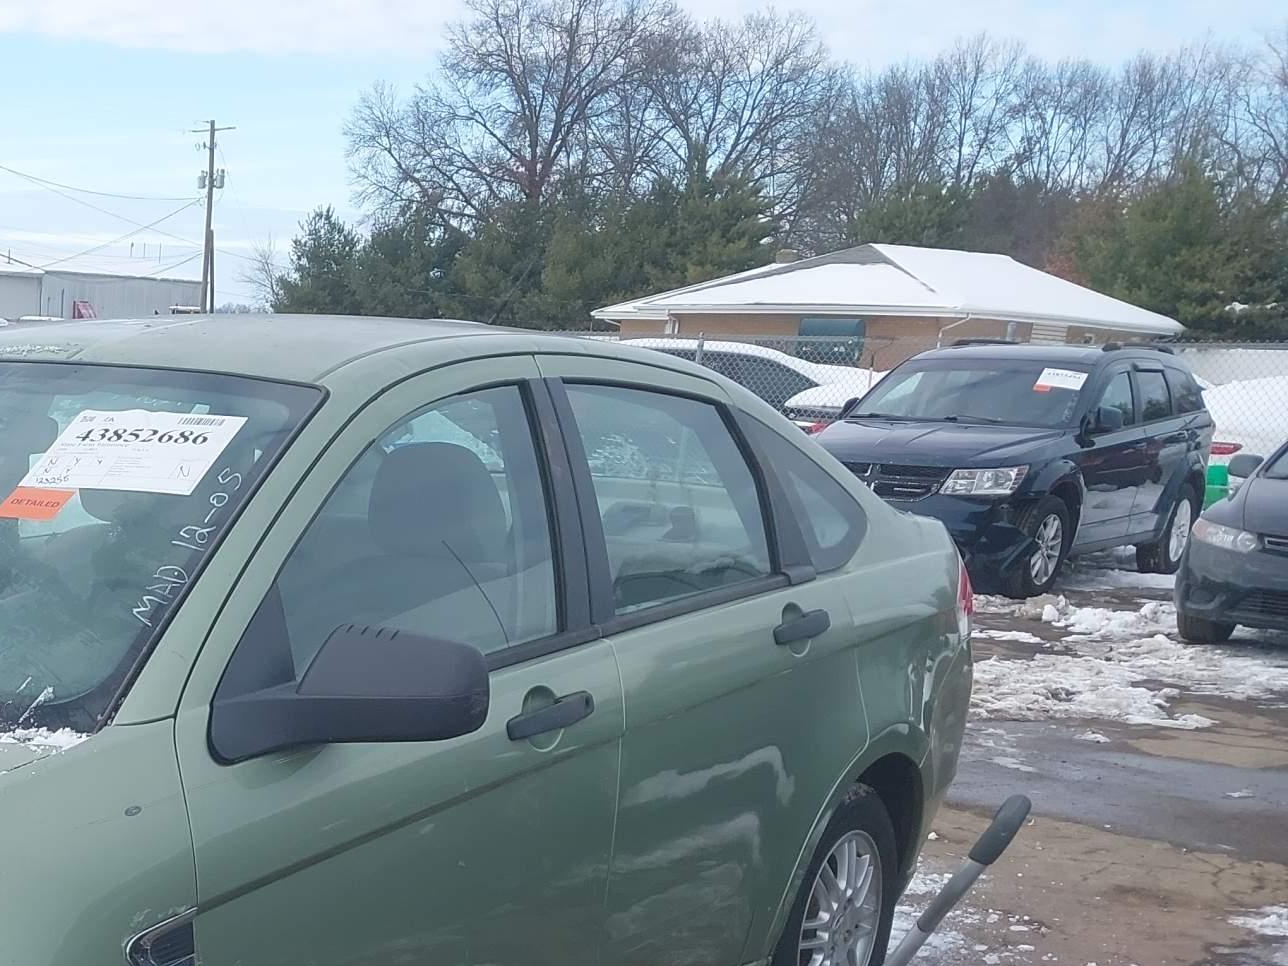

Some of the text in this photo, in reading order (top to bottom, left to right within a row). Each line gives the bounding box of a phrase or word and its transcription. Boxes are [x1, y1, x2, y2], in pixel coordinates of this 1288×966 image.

[75, 428, 215, 445] 43852686
[10, 498, 61, 508] DETAILED
[132, 565, 189, 627] MAD
